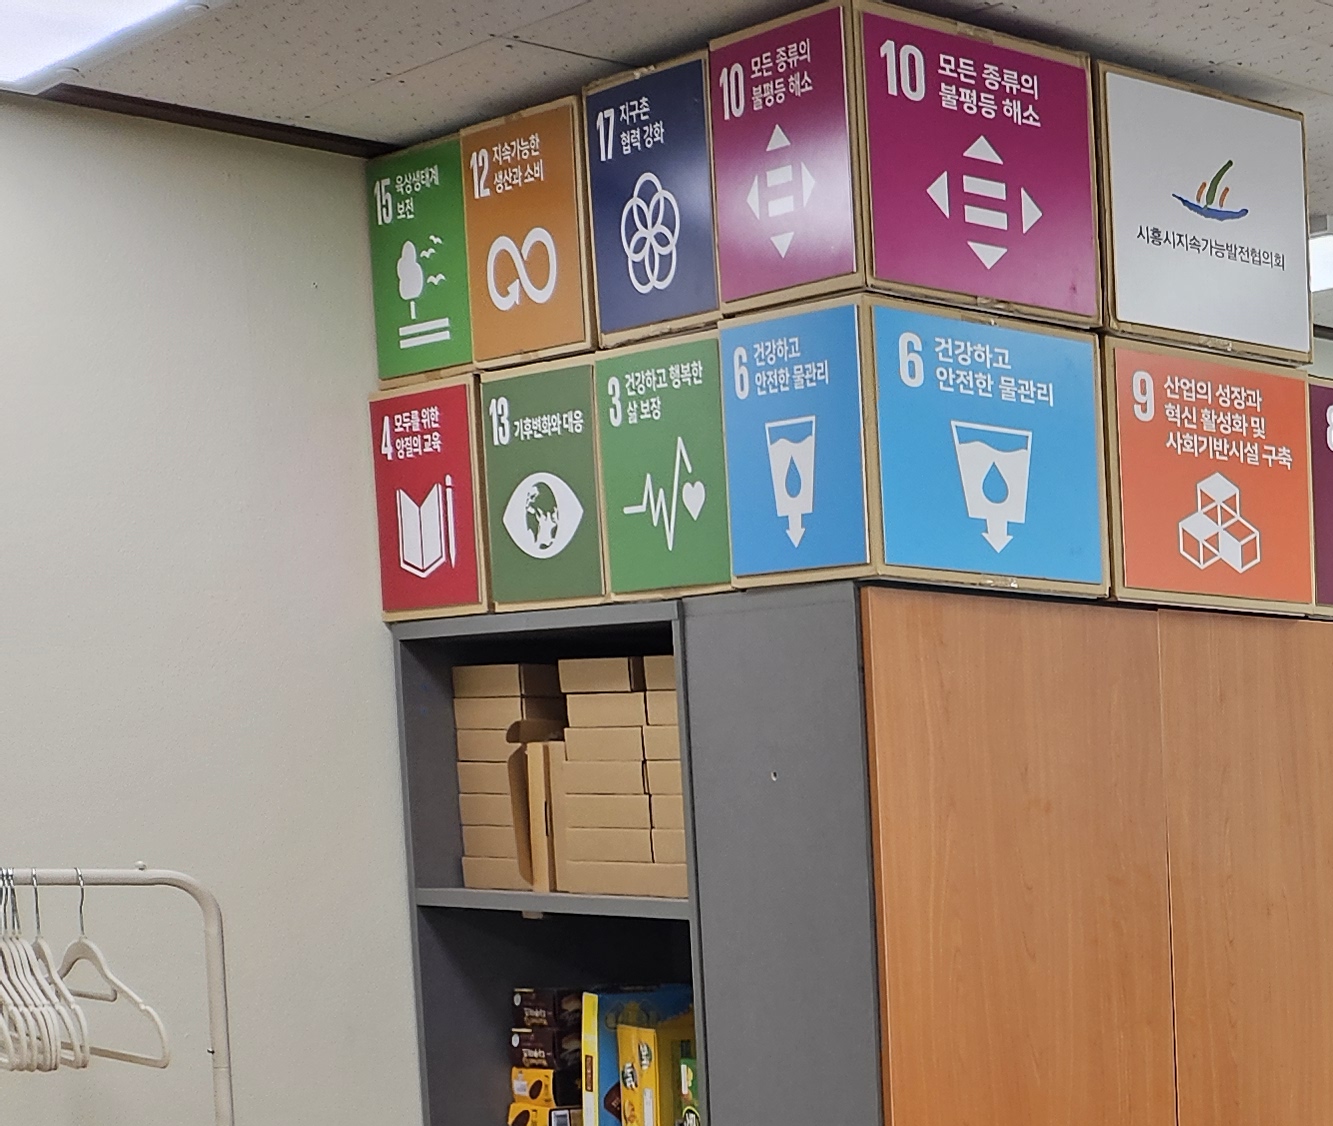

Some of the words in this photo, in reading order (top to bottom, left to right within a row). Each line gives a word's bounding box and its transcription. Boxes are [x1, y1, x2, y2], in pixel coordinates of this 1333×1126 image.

[751, 53, 773, 78] 모든
[776, 38, 811, 71] 종류의
[879, 39, 925, 101] 10
[938, 53, 977, 85] 모든
[982, 62, 1039, 99] 종류의
[720, 63, 744, 119] 10
[751, 79, 786, 110] 불평등
[788, 71, 813, 97] 해소
[938, 82, 998, 119] 불평등
[1003, 98, 1041, 128] 해소
[620, 97, 650, 125] 지구촌
[492, 133, 540, 164] 지속가능한
[597, 109, 615, 161] 17
[620, 129, 641, 154] 협력
[643, 121, 664, 146] 강화
[395, 164, 440, 196] 육상생태계
[469, 148, 490, 199] 12
[493, 169, 521, 193] 생산과
[523, 159, 544, 184] 소비
[373, 178, 393, 225] 15
[397, 197, 414, 219] 보전
[1137, 223, 1286, 271] 시흥시지속가능발전협의회
[753, 337, 801, 365] 건강하고
[898, 332, 925, 387] 6
[934, 336, 1011, 370] 건강하고
[624, 370, 667, 397] 건강하고
[669, 360, 703, 389] 행복한
[733, 346, 749, 400] 6
[755, 369, 790, 397] 안전한
[792, 359, 829, 391] 물관리
[935, 367, 994, 398] 안전한
[998, 377, 1054, 407] 물관리
[608, 376, 622, 427] 3
[627, 401, 638, 420] 삶
[640, 395, 662, 419] 보장
[1132, 370, 1154, 421] 9
[1163, 376, 1211, 405] 산업의
[1215, 384, 1262, 413] 성장과
[380, 415, 392, 460] 4
[394, 411, 420, 434] 모두를
[421, 405, 439, 430] 위한
[489, 396, 510, 446] 13
[514, 412, 561, 441] 기후변화와
[563, 408, 584, 434] 대응
[1165, 402, 1197, 429] 혁신
[1200, 407, 1248, 436] 활성화
[1250, 416, 1265, 439] 및
[395, 435, 422, 459] 양질의
[423, 432, 442, 454] 교육
[1165, 431, 1259, 465] 사회기반시설
[1263, 444, 1293, 471] 구축
